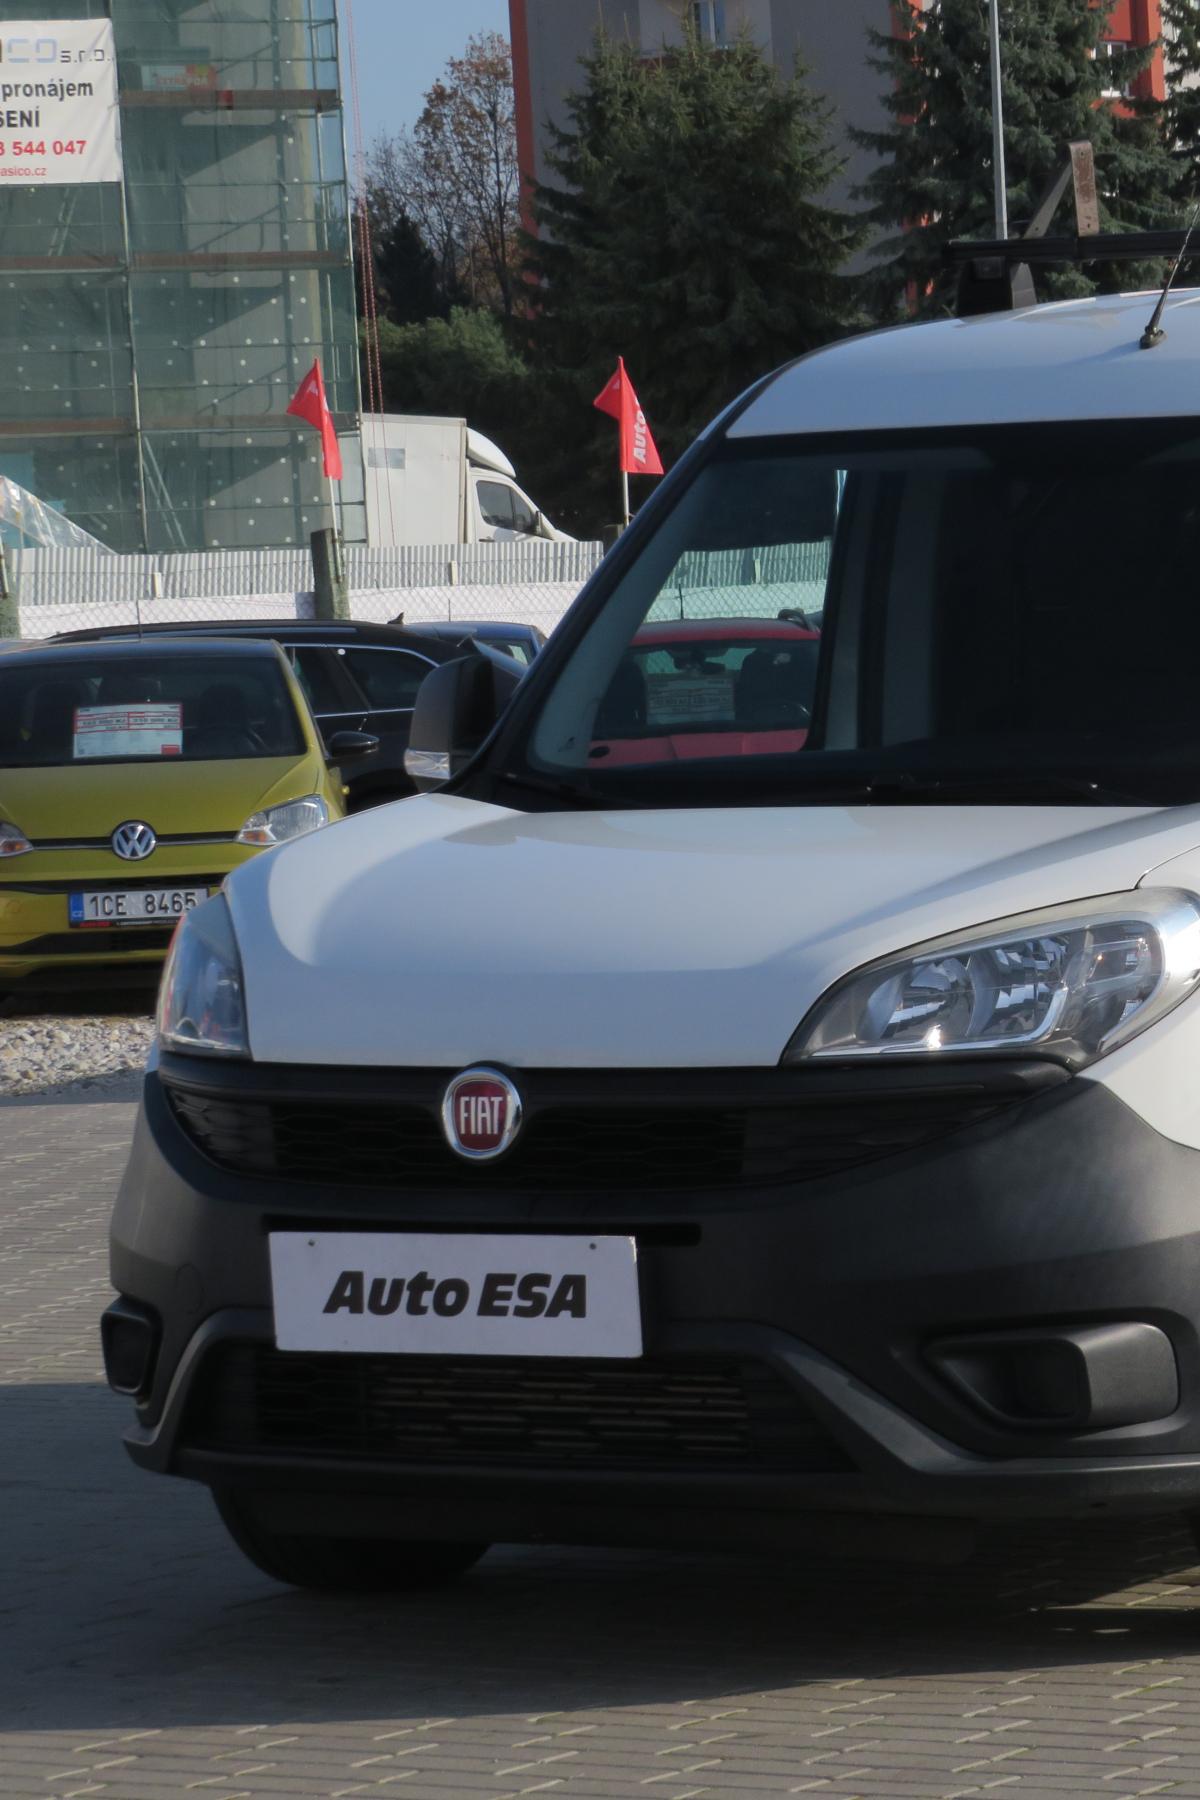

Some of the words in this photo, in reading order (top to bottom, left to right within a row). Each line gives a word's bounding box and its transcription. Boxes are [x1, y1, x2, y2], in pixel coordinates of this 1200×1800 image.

[0, 38, 57, 63] CO
[60, 49, 111, 63] s.r.o.
[1, 79, 93, 102] pronájem
[12, 141, 46, 156] 544
[53, 140, 87, 155] 047
[90, 894, 127, 917] 1CE
[459, 1096, 503, 1135] FIAT
[322, 1270, 470, 1317] Auto
[476, 1272, 587, 1319] ESA
